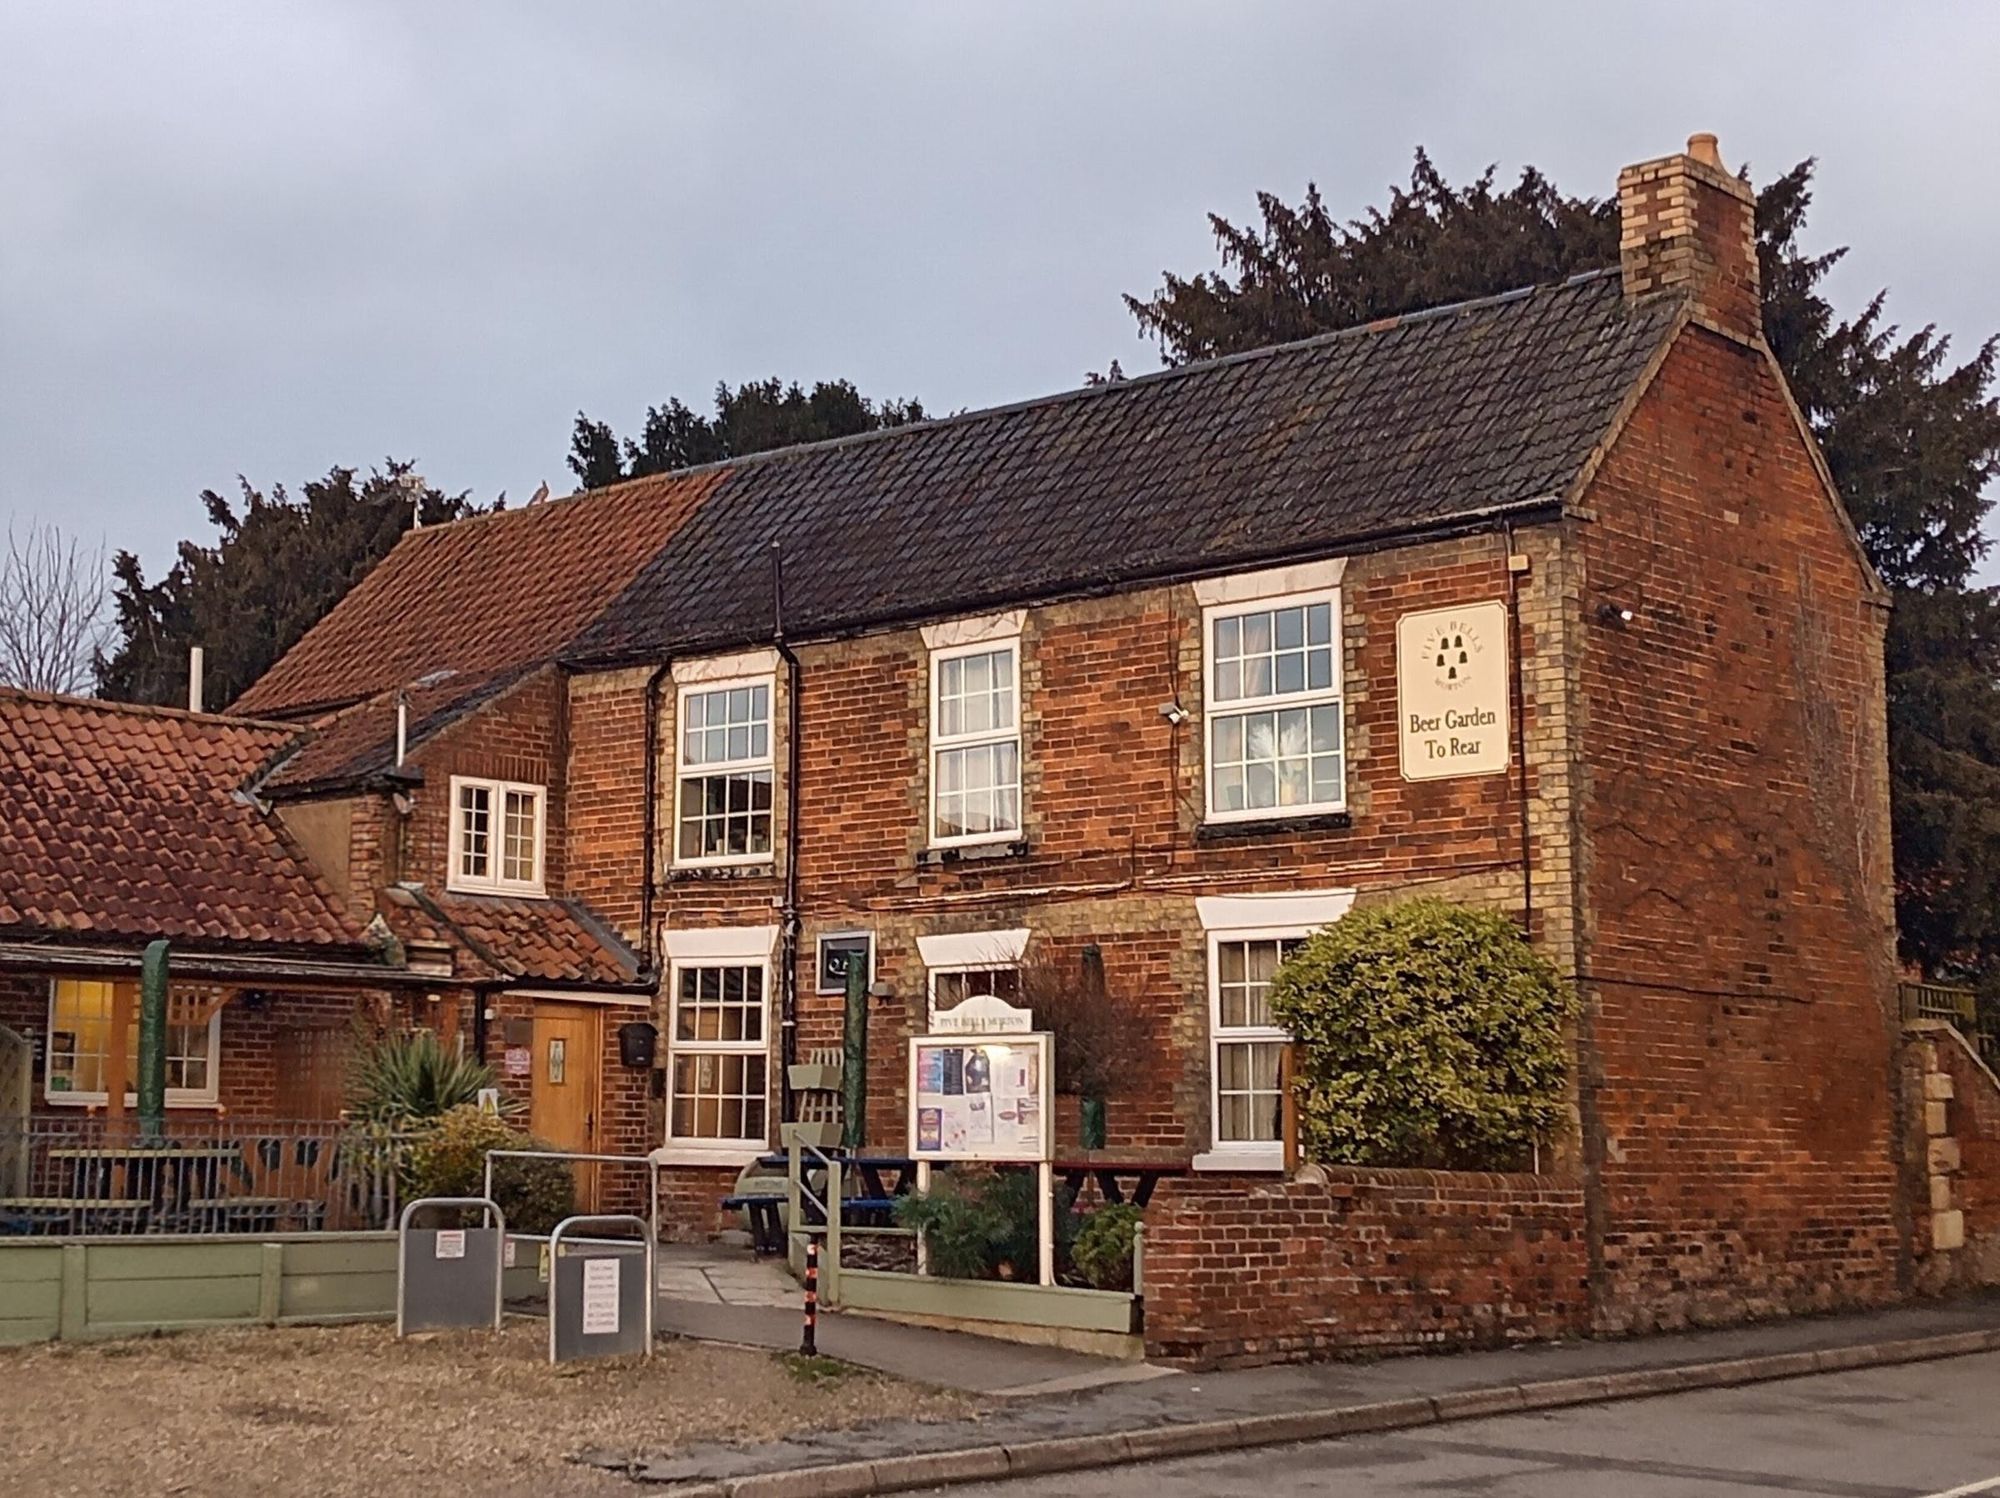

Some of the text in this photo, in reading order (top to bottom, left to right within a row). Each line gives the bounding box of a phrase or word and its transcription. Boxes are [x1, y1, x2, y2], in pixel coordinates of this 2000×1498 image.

[1450, 620, 1484, 654] BELLS
[1410, 706, 1496, 733] Beer Garden
[1424, 737, 1481, 759] To Rear
